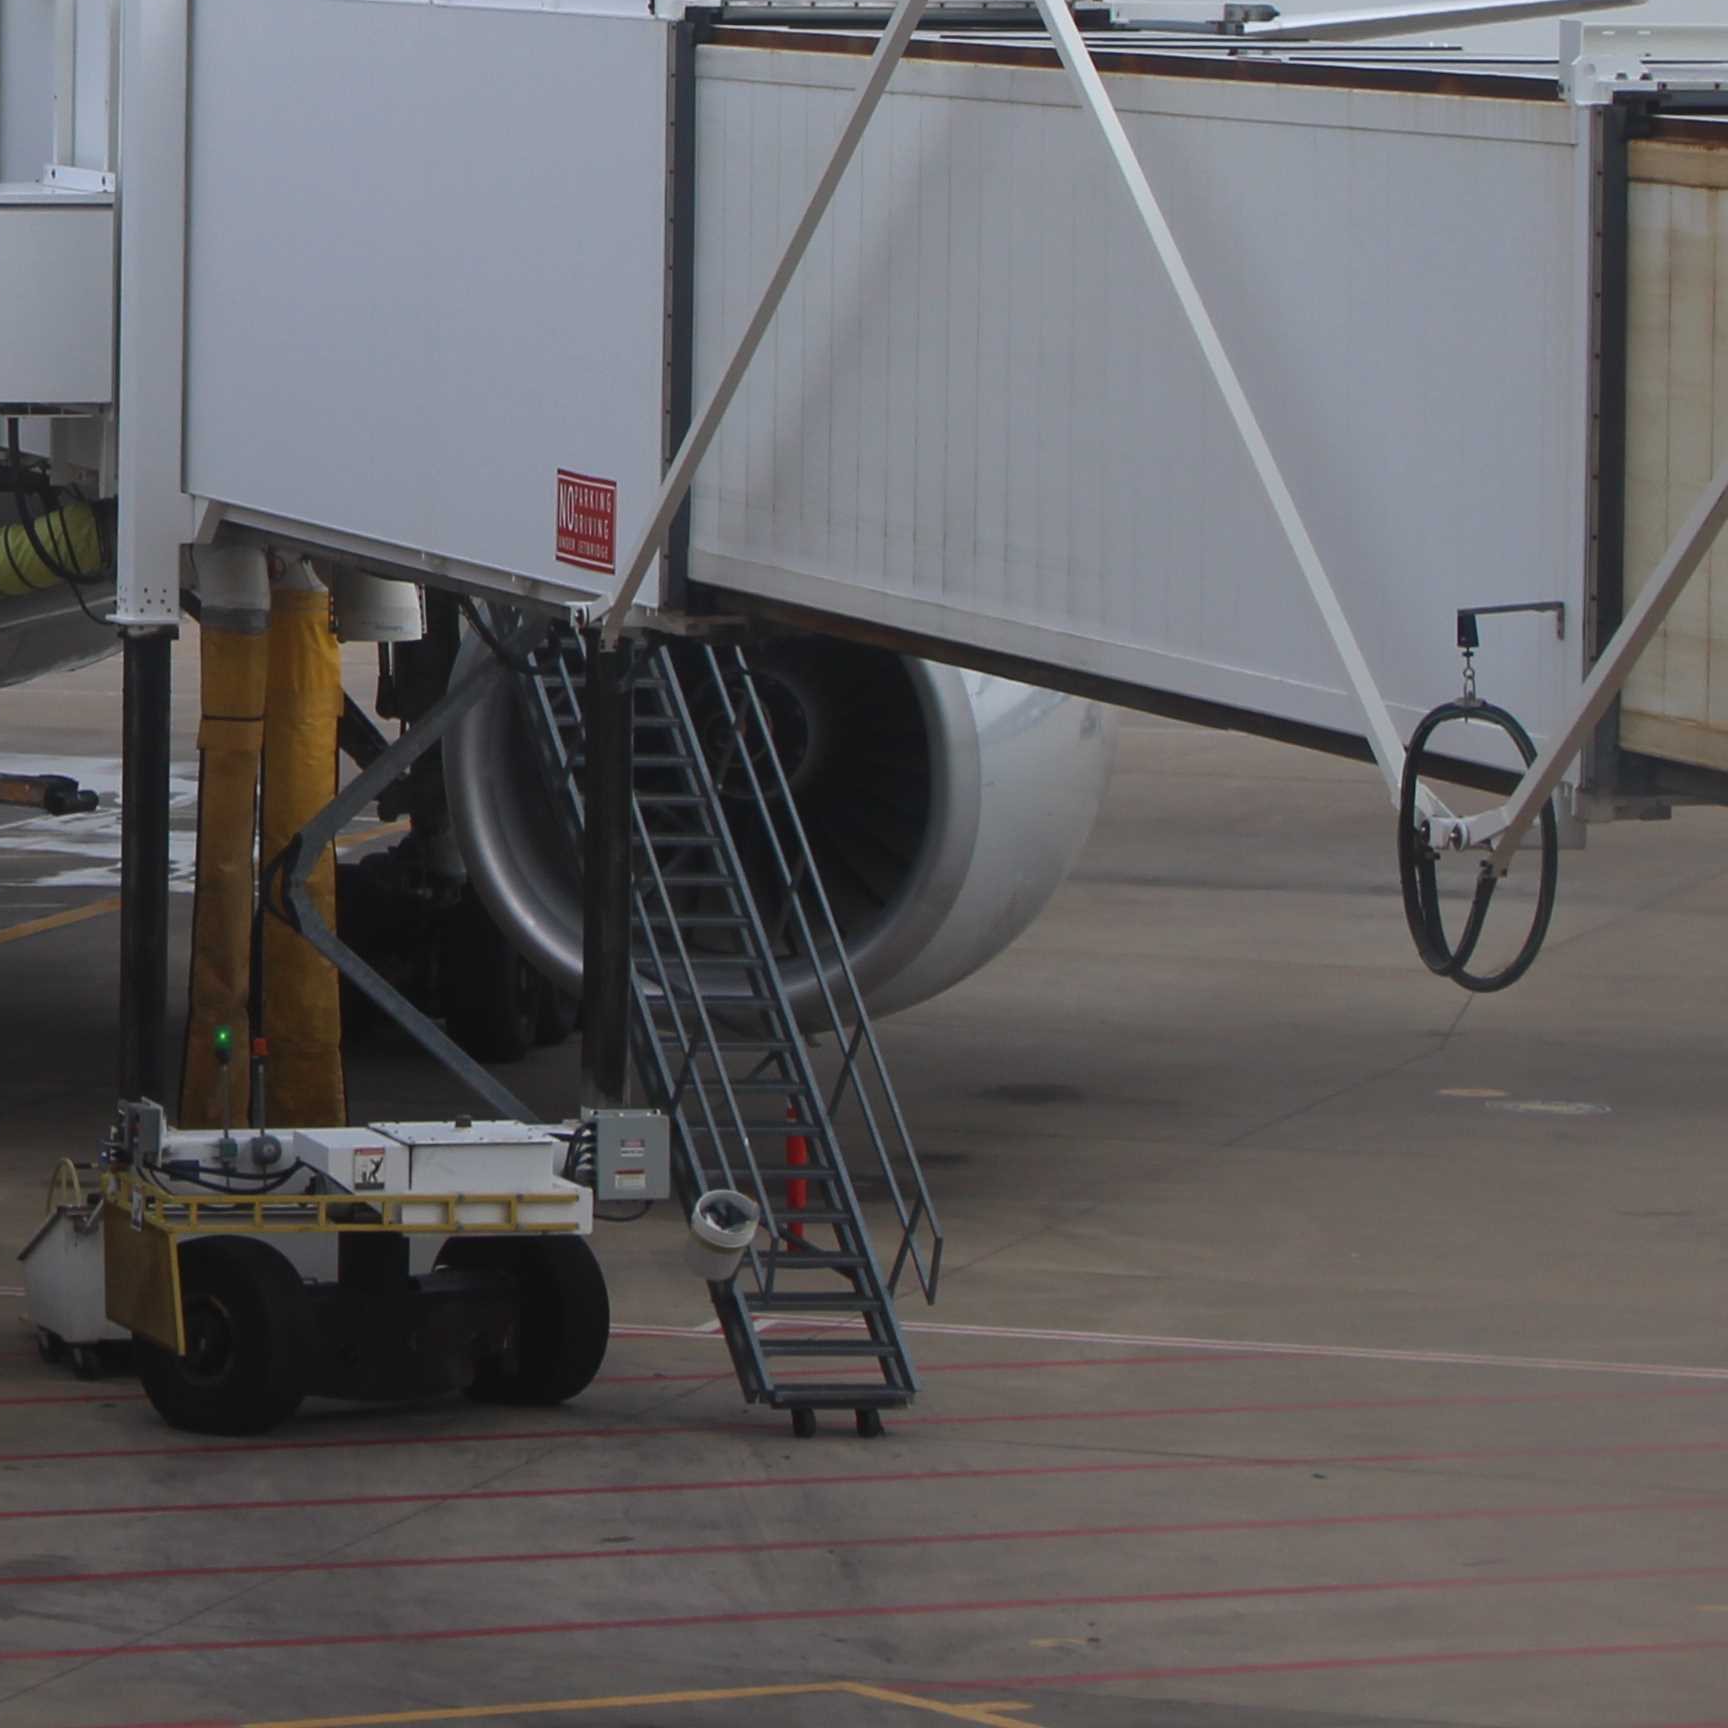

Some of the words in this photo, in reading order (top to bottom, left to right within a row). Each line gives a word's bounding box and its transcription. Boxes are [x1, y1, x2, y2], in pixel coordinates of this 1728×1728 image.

[559, 483, 575, 531] NO
[574, 486, 611, 513] PARKING
[574, 513, 609, 540] DRIVING
